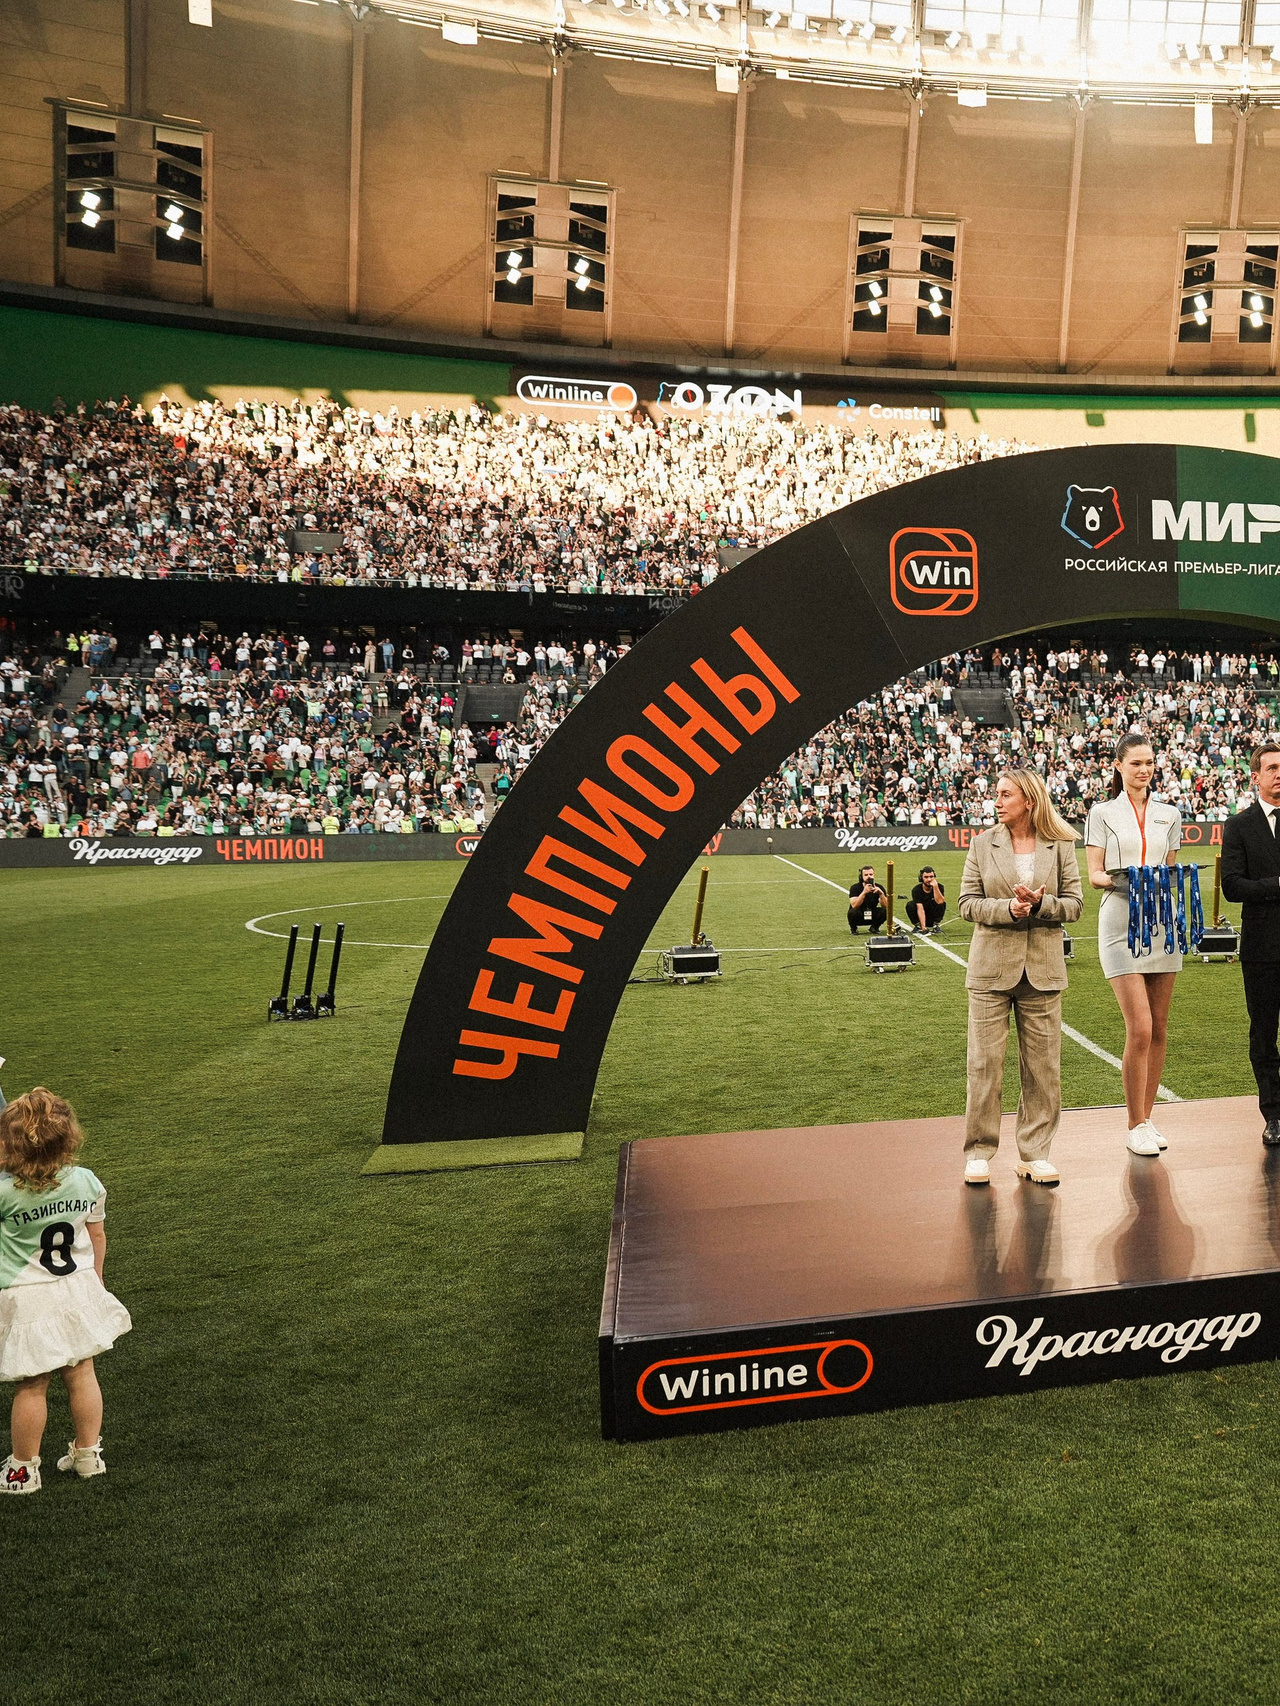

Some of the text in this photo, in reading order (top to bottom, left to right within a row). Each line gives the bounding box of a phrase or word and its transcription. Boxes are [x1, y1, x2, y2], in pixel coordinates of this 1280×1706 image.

[527, 382, 604, 403] Winline
[675, 382, 802, 416] OZON
[868, 403, 940, 421] Constell
[909, 559, 971, 586] Win
[1064, 557, 1168, 573] РОССИЙСКАЯ
[69, 838, 324, 866] Краснодар ЧЕМПИОН
[452, 626, 801, 1080] ЧЕМПИОНЫ
[834, 828, 938, 852] Краснодар
[12, 1199, 88, 1226] ГАЗИНСКАЯ
[39, 1221, 77, 1276] 8
[975, 1312, 1262, 1377] Краснодар
[659, 1362, 808, 1400] Winline
